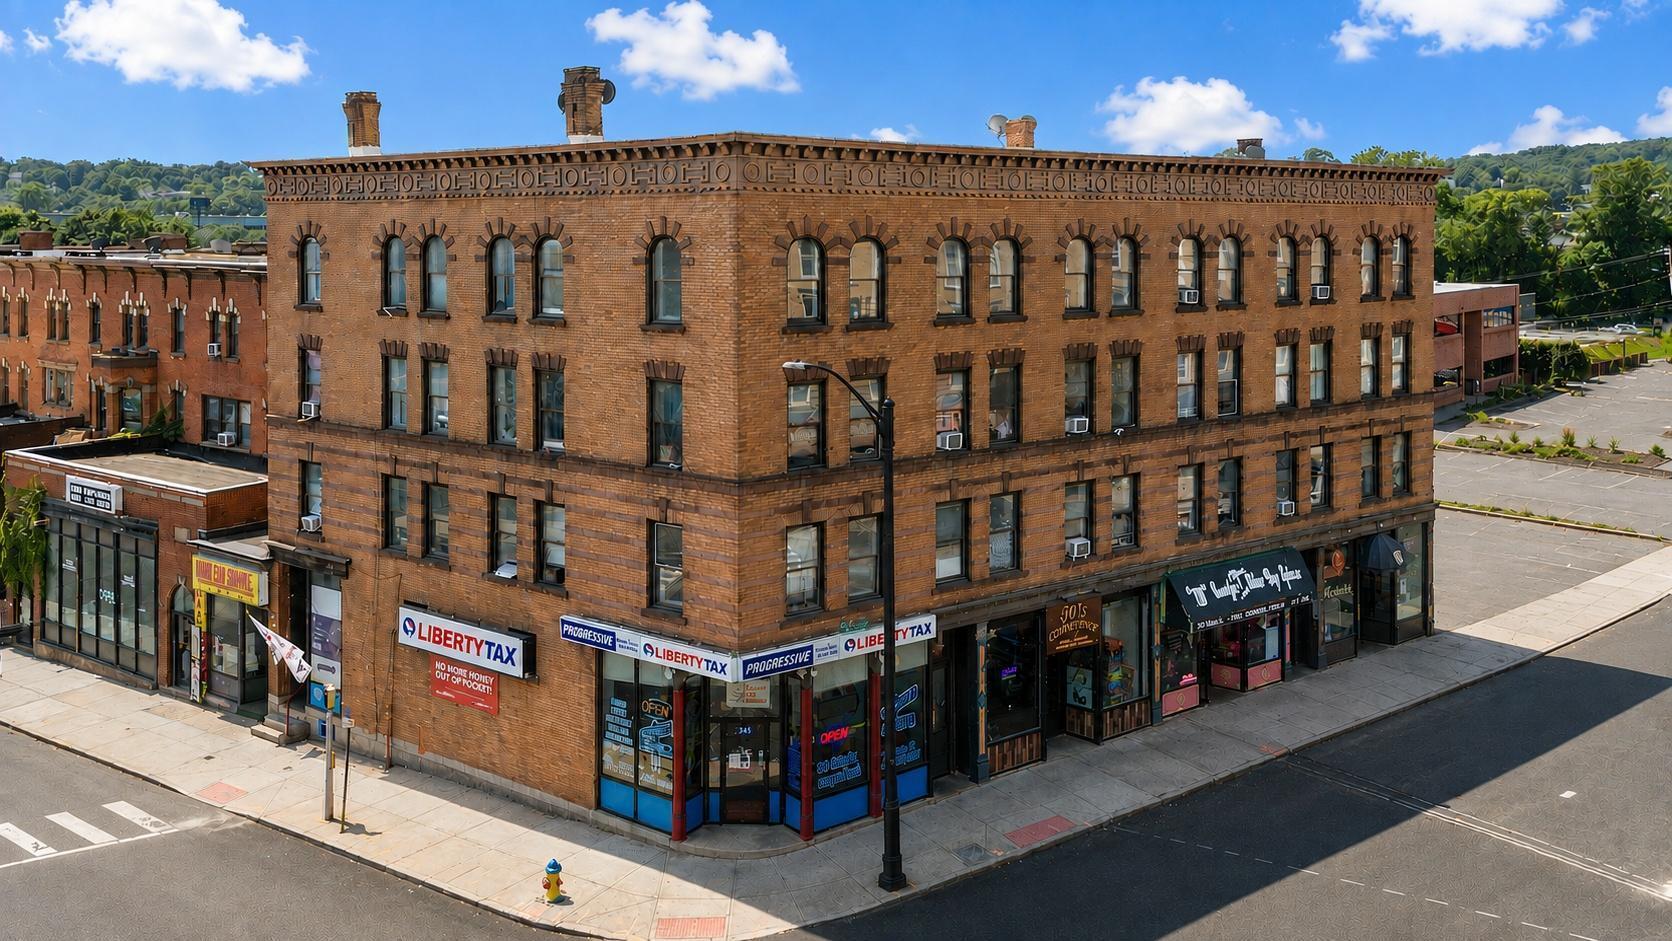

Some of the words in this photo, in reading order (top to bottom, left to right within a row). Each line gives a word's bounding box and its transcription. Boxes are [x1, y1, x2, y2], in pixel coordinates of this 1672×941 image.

[563, 624, 614, 647] PROGRESSIVE
[435, 661, 446, 671] NO
[745, 650, 811, 675] PROGRESSIVE
[435, 670, 450, 681] OUT
[642, 700, 669, 718] OPEN
[820, 726, 849, 745] OPEN
